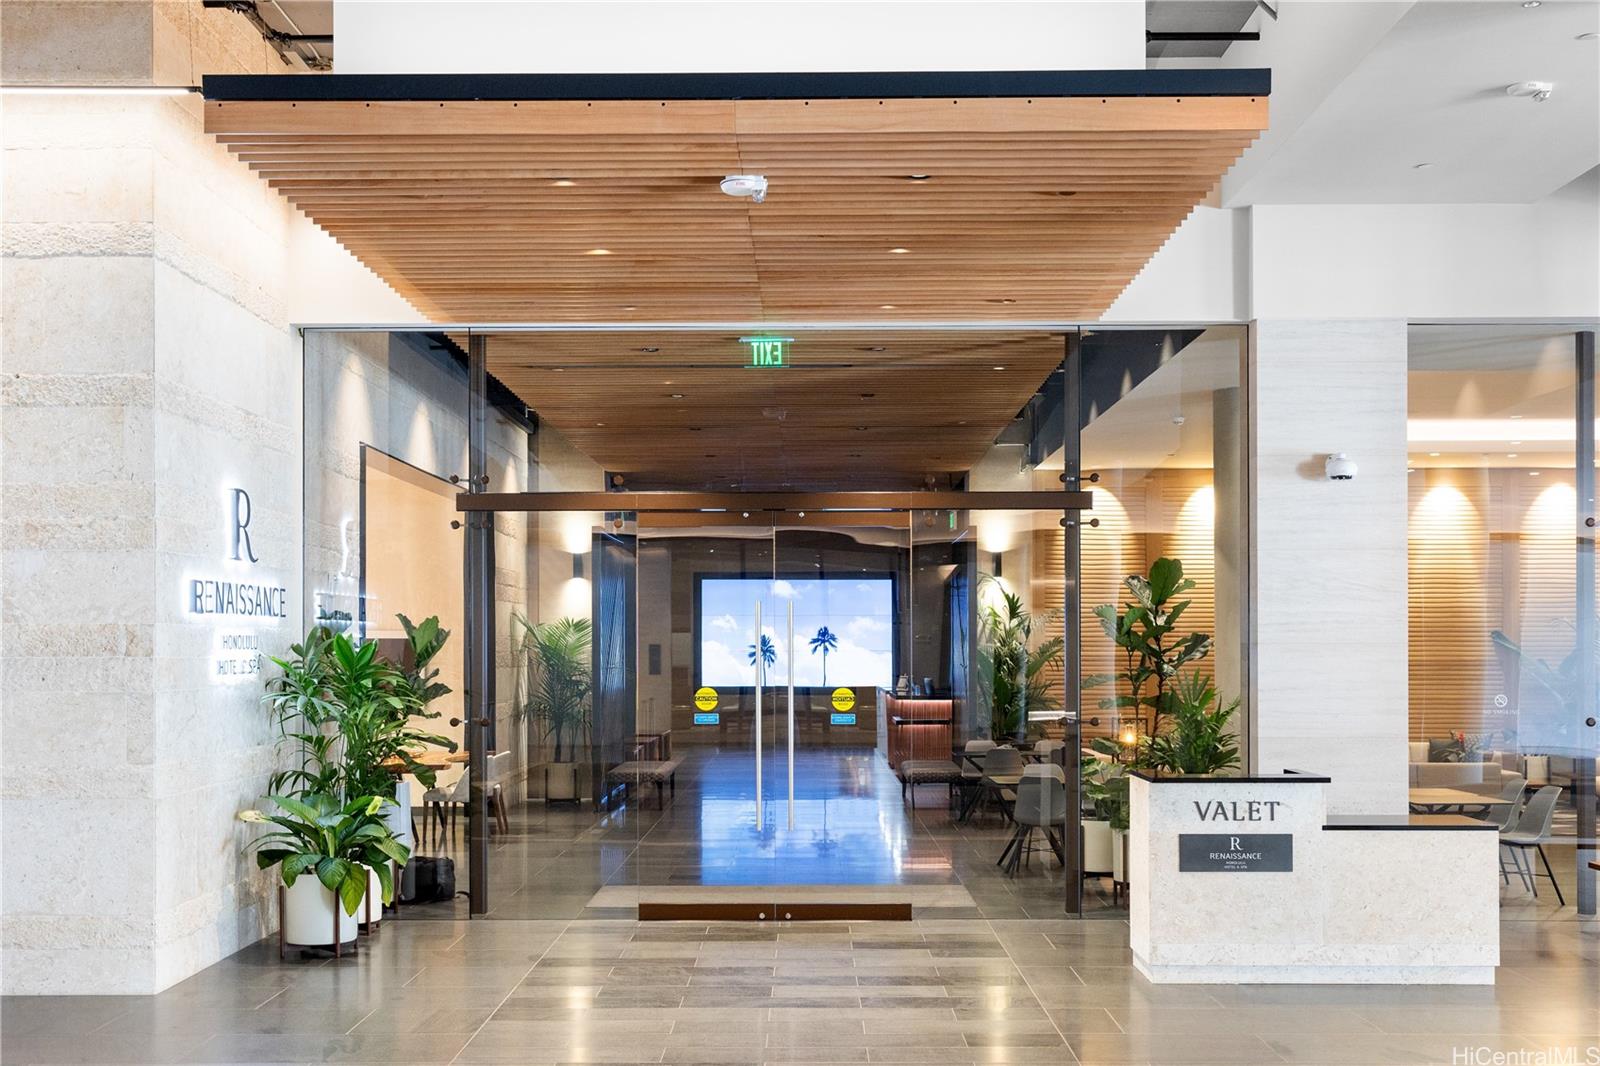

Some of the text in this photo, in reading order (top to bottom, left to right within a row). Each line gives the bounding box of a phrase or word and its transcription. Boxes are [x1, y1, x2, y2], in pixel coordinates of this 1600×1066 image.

[229, 488, 259, 563] R
[189, 580, 286, 617] RENAISSANCE
[1193, 801, 1280, 821] VALET
[1230, 836, 1244, 851] R
[1209, 852, 1262, 860] RENAISSANCE
